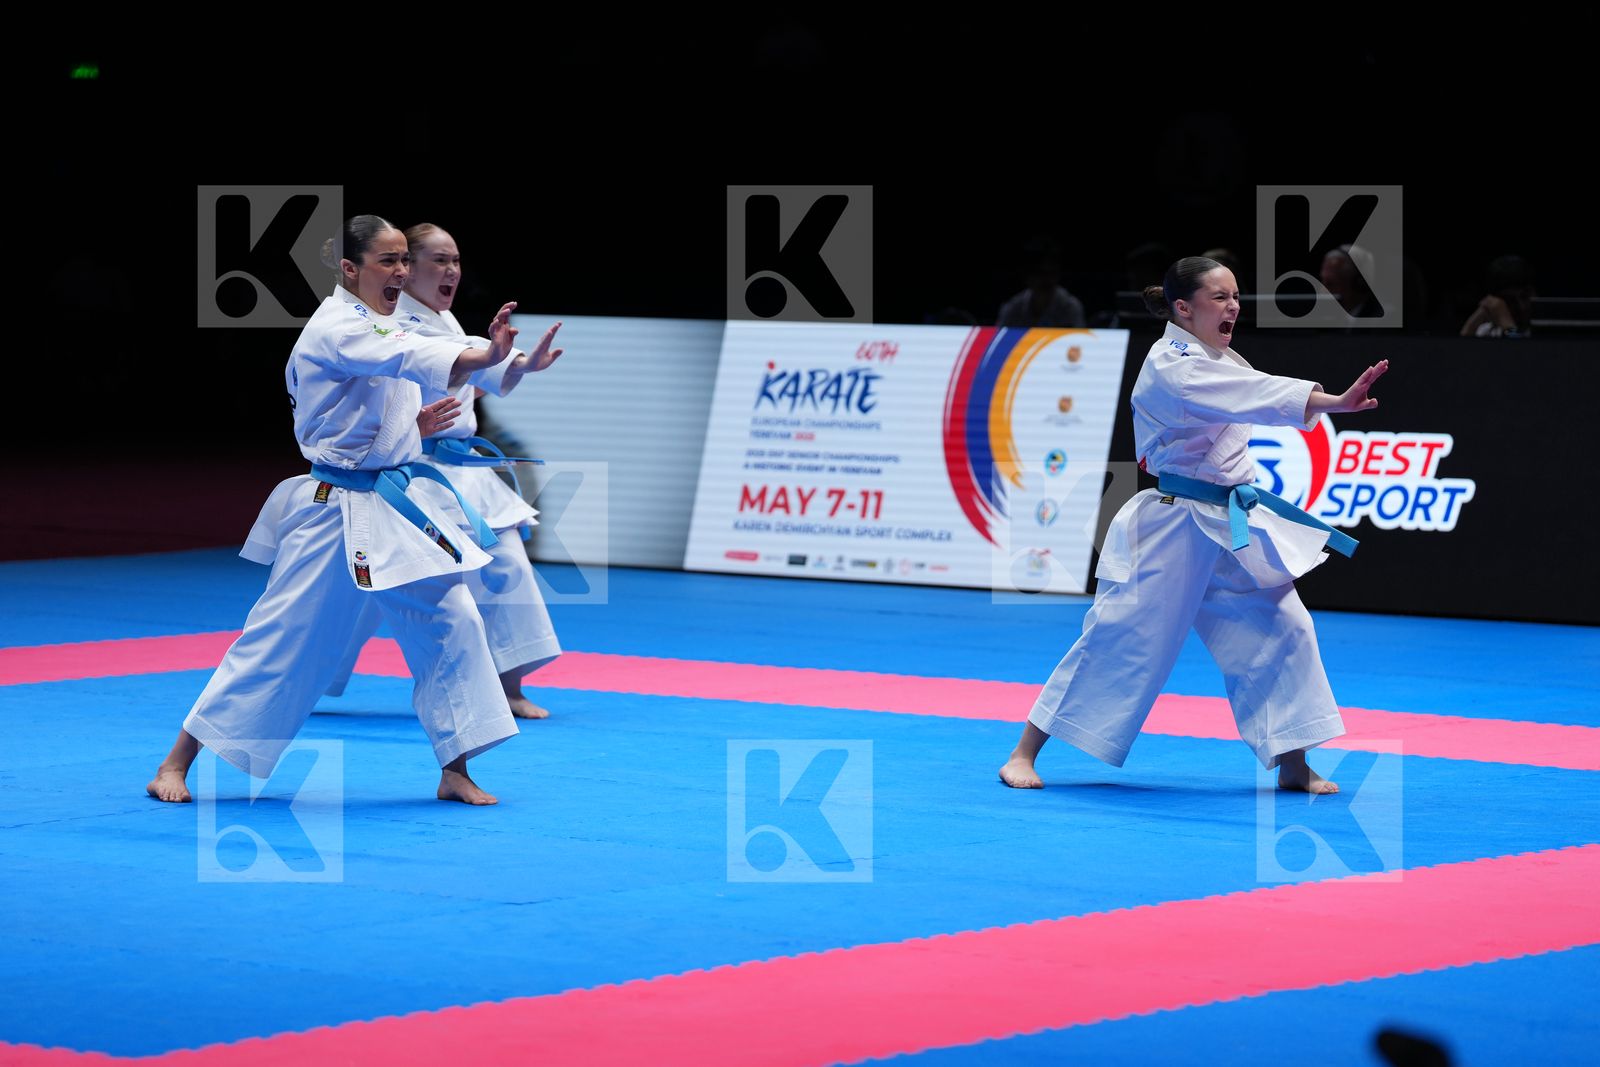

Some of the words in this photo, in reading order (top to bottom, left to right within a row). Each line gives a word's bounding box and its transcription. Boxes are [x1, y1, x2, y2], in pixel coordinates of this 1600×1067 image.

[754, 366, 884, 414] KARATE
[1335, 440, 1444, 477] BEST
[738, 484, 817, 516] MAY
[826, 488, 884, 520] 7-11
[1321, 484, 1467, 523] SPORT
[733, 520, 772, 532] KAREN
[855, 525, 893, 539] SPORT
[895, 528, 953, 542] COMPLEX
